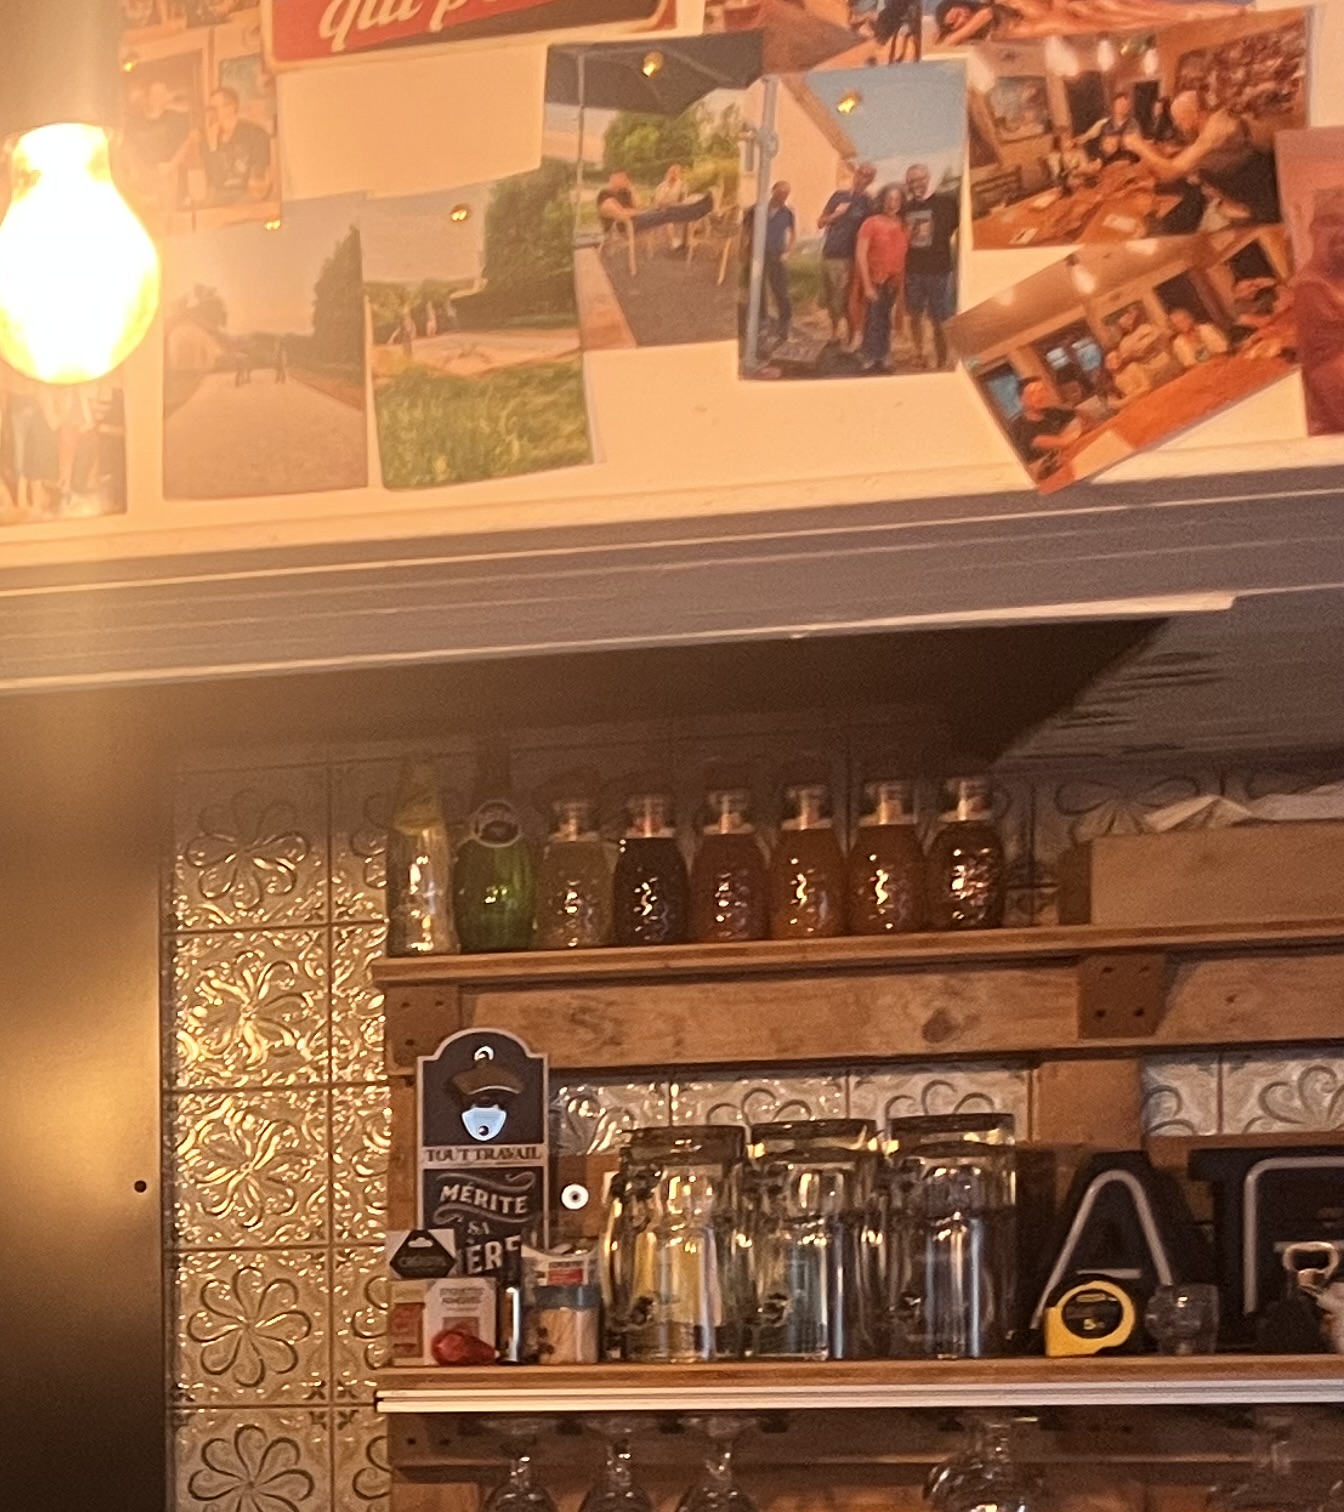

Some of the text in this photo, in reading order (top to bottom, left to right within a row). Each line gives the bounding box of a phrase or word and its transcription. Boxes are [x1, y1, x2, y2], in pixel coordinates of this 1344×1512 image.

[425, 1146, 541, 1162] TOUT TRAVAIL
[440, 1181, 529, 1214] MÉRITE
